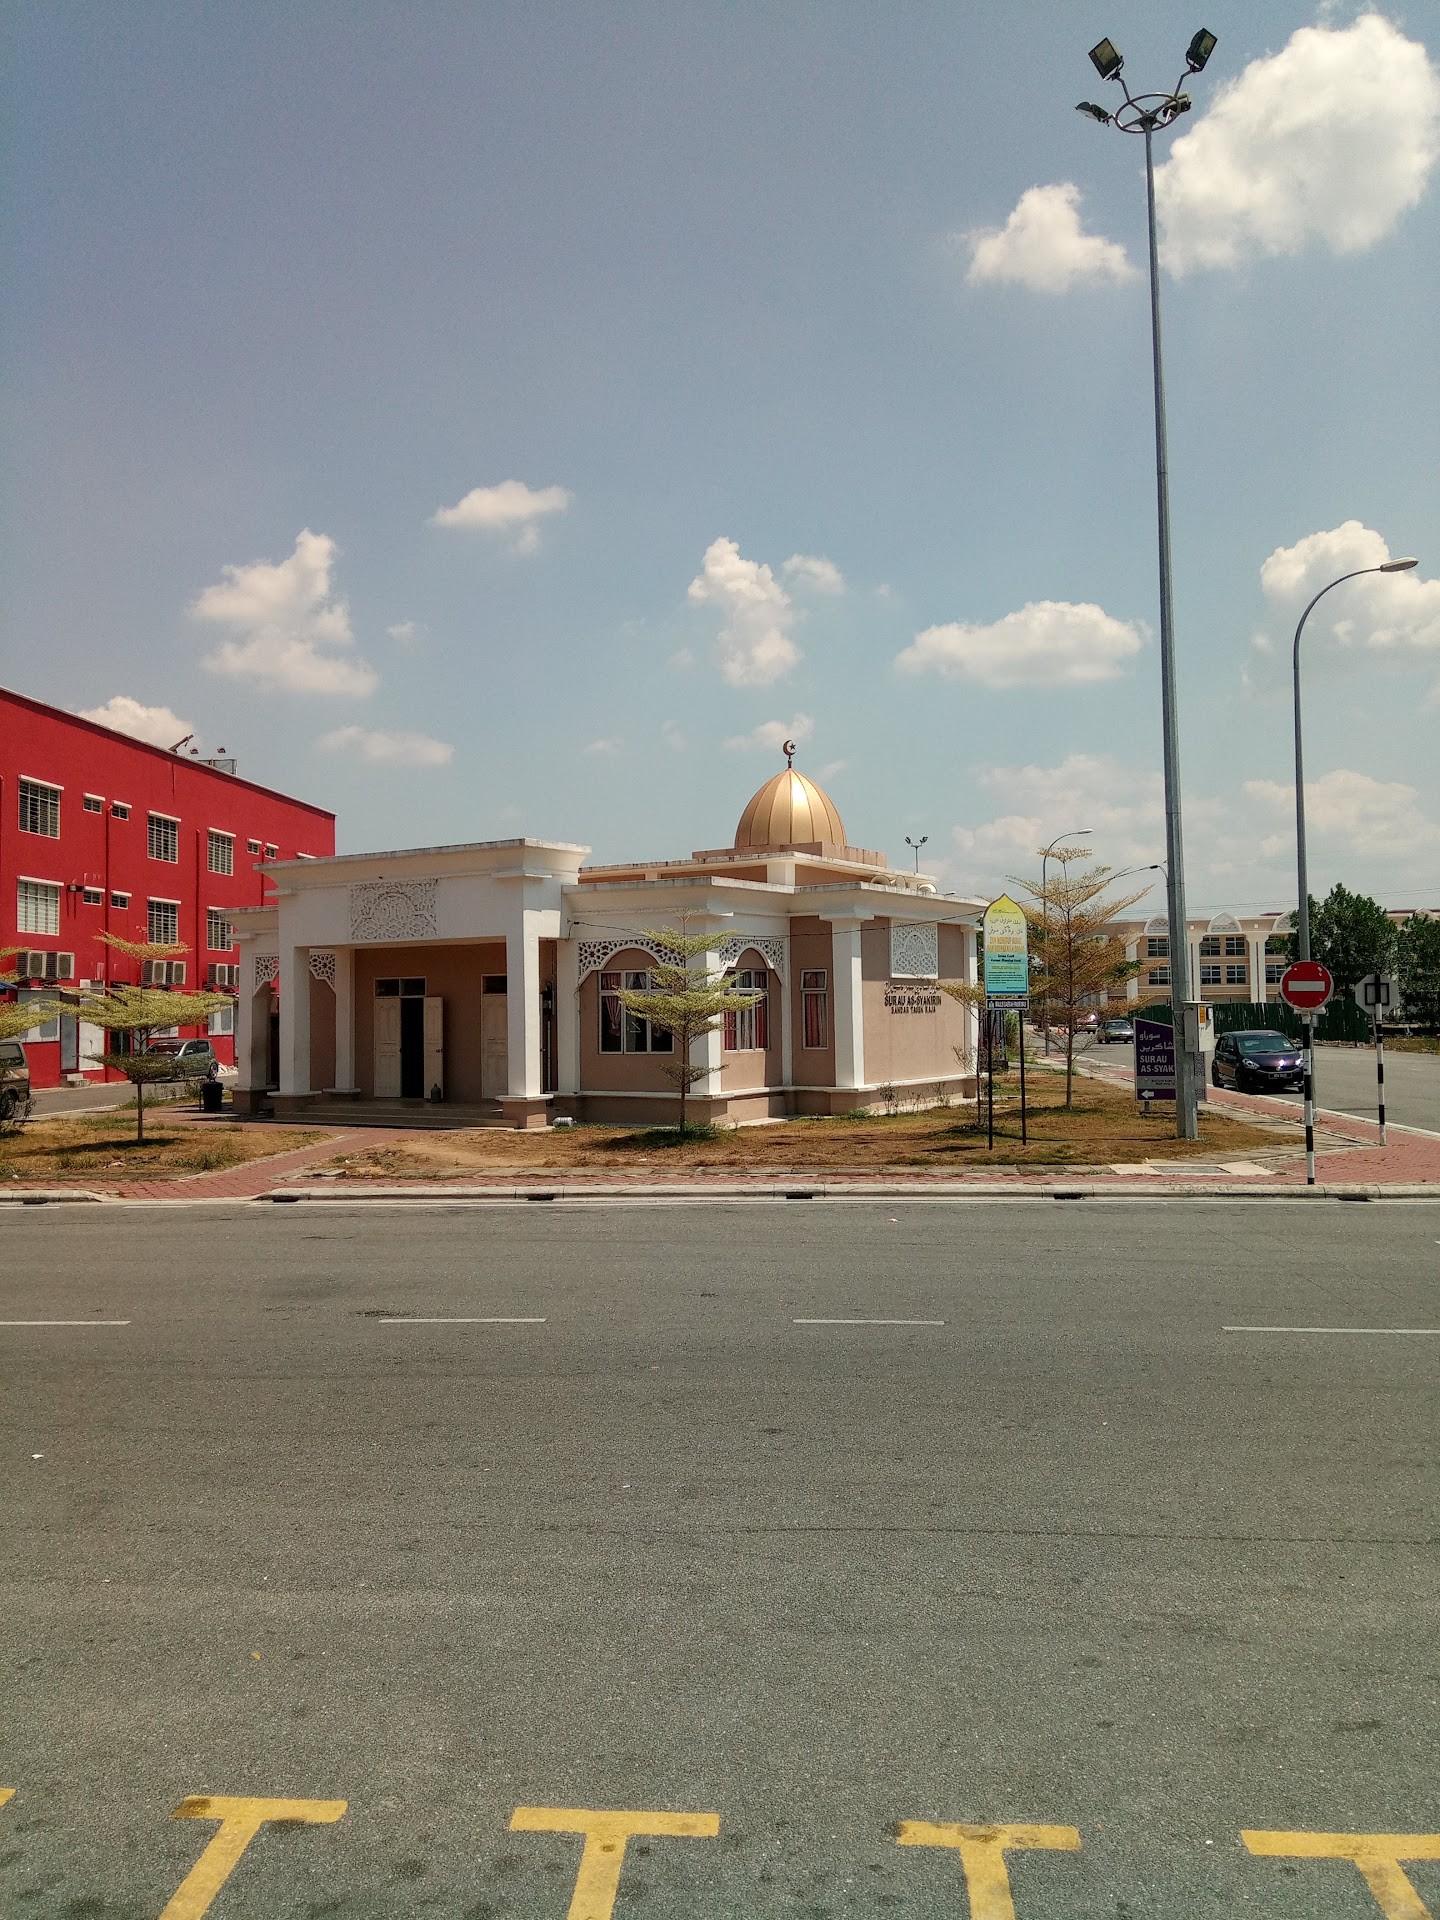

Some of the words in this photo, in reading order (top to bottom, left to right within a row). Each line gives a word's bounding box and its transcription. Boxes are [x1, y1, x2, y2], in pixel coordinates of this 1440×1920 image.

[884, 995, 905, 1006] SURAU
[907, 995, 941, 1006] AS-SYAKIRIN
[1139, 1030, 1160, 1041] سوراو
[1139, 1041, 1175, 1053] شاكرين
[1140, 1055, 1167, 1063] SURAU
